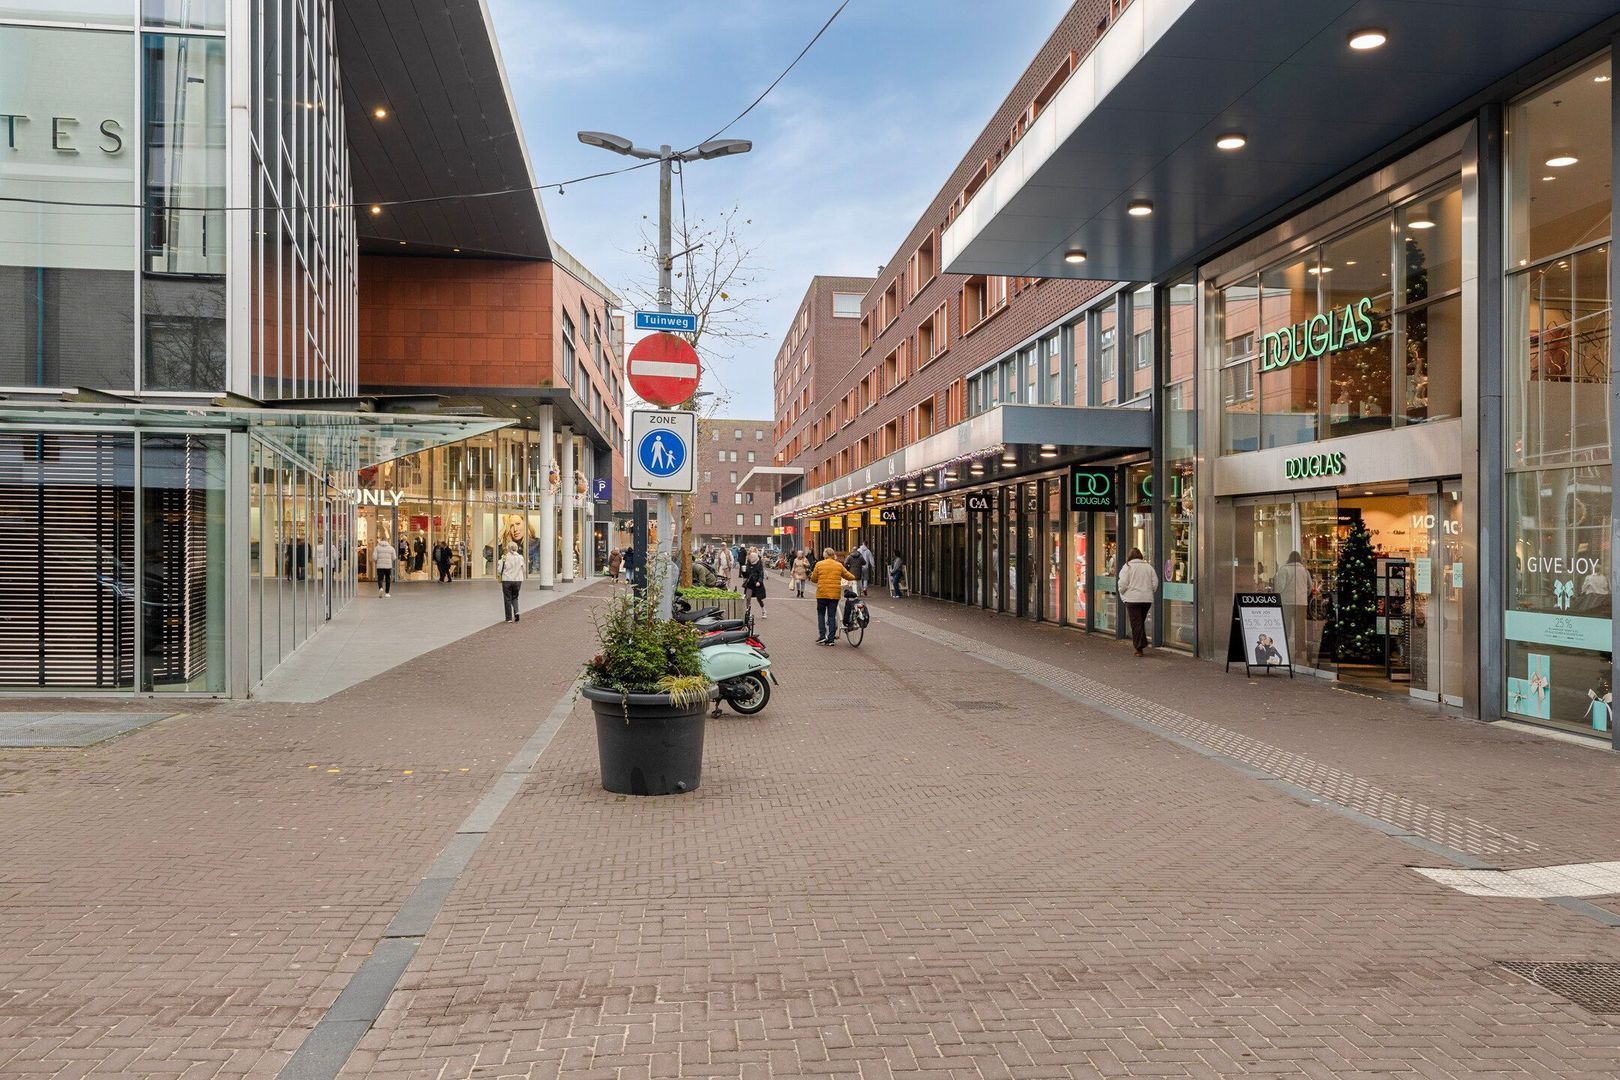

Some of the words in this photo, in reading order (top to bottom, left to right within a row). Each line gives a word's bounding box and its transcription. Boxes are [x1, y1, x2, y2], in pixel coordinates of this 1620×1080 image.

[0, 114, 122, 153] TES
[644, 315, 689, 328] Tuinweg
[1263, 297, 1373, 371] DOUGLAS
[649, 416, 677, 425] ZONE
[1285, 451, 1343, 479] DOUGLAS
[348, 488, 404, 506] ONLY
[1076, 497, 1111, 505] DOUGLAS
[1527, 557, 1562, 573] GIVE
[1567, 557, 1599, 575] JOY
[1242, 596, 1277, 604] DOUGLAS
